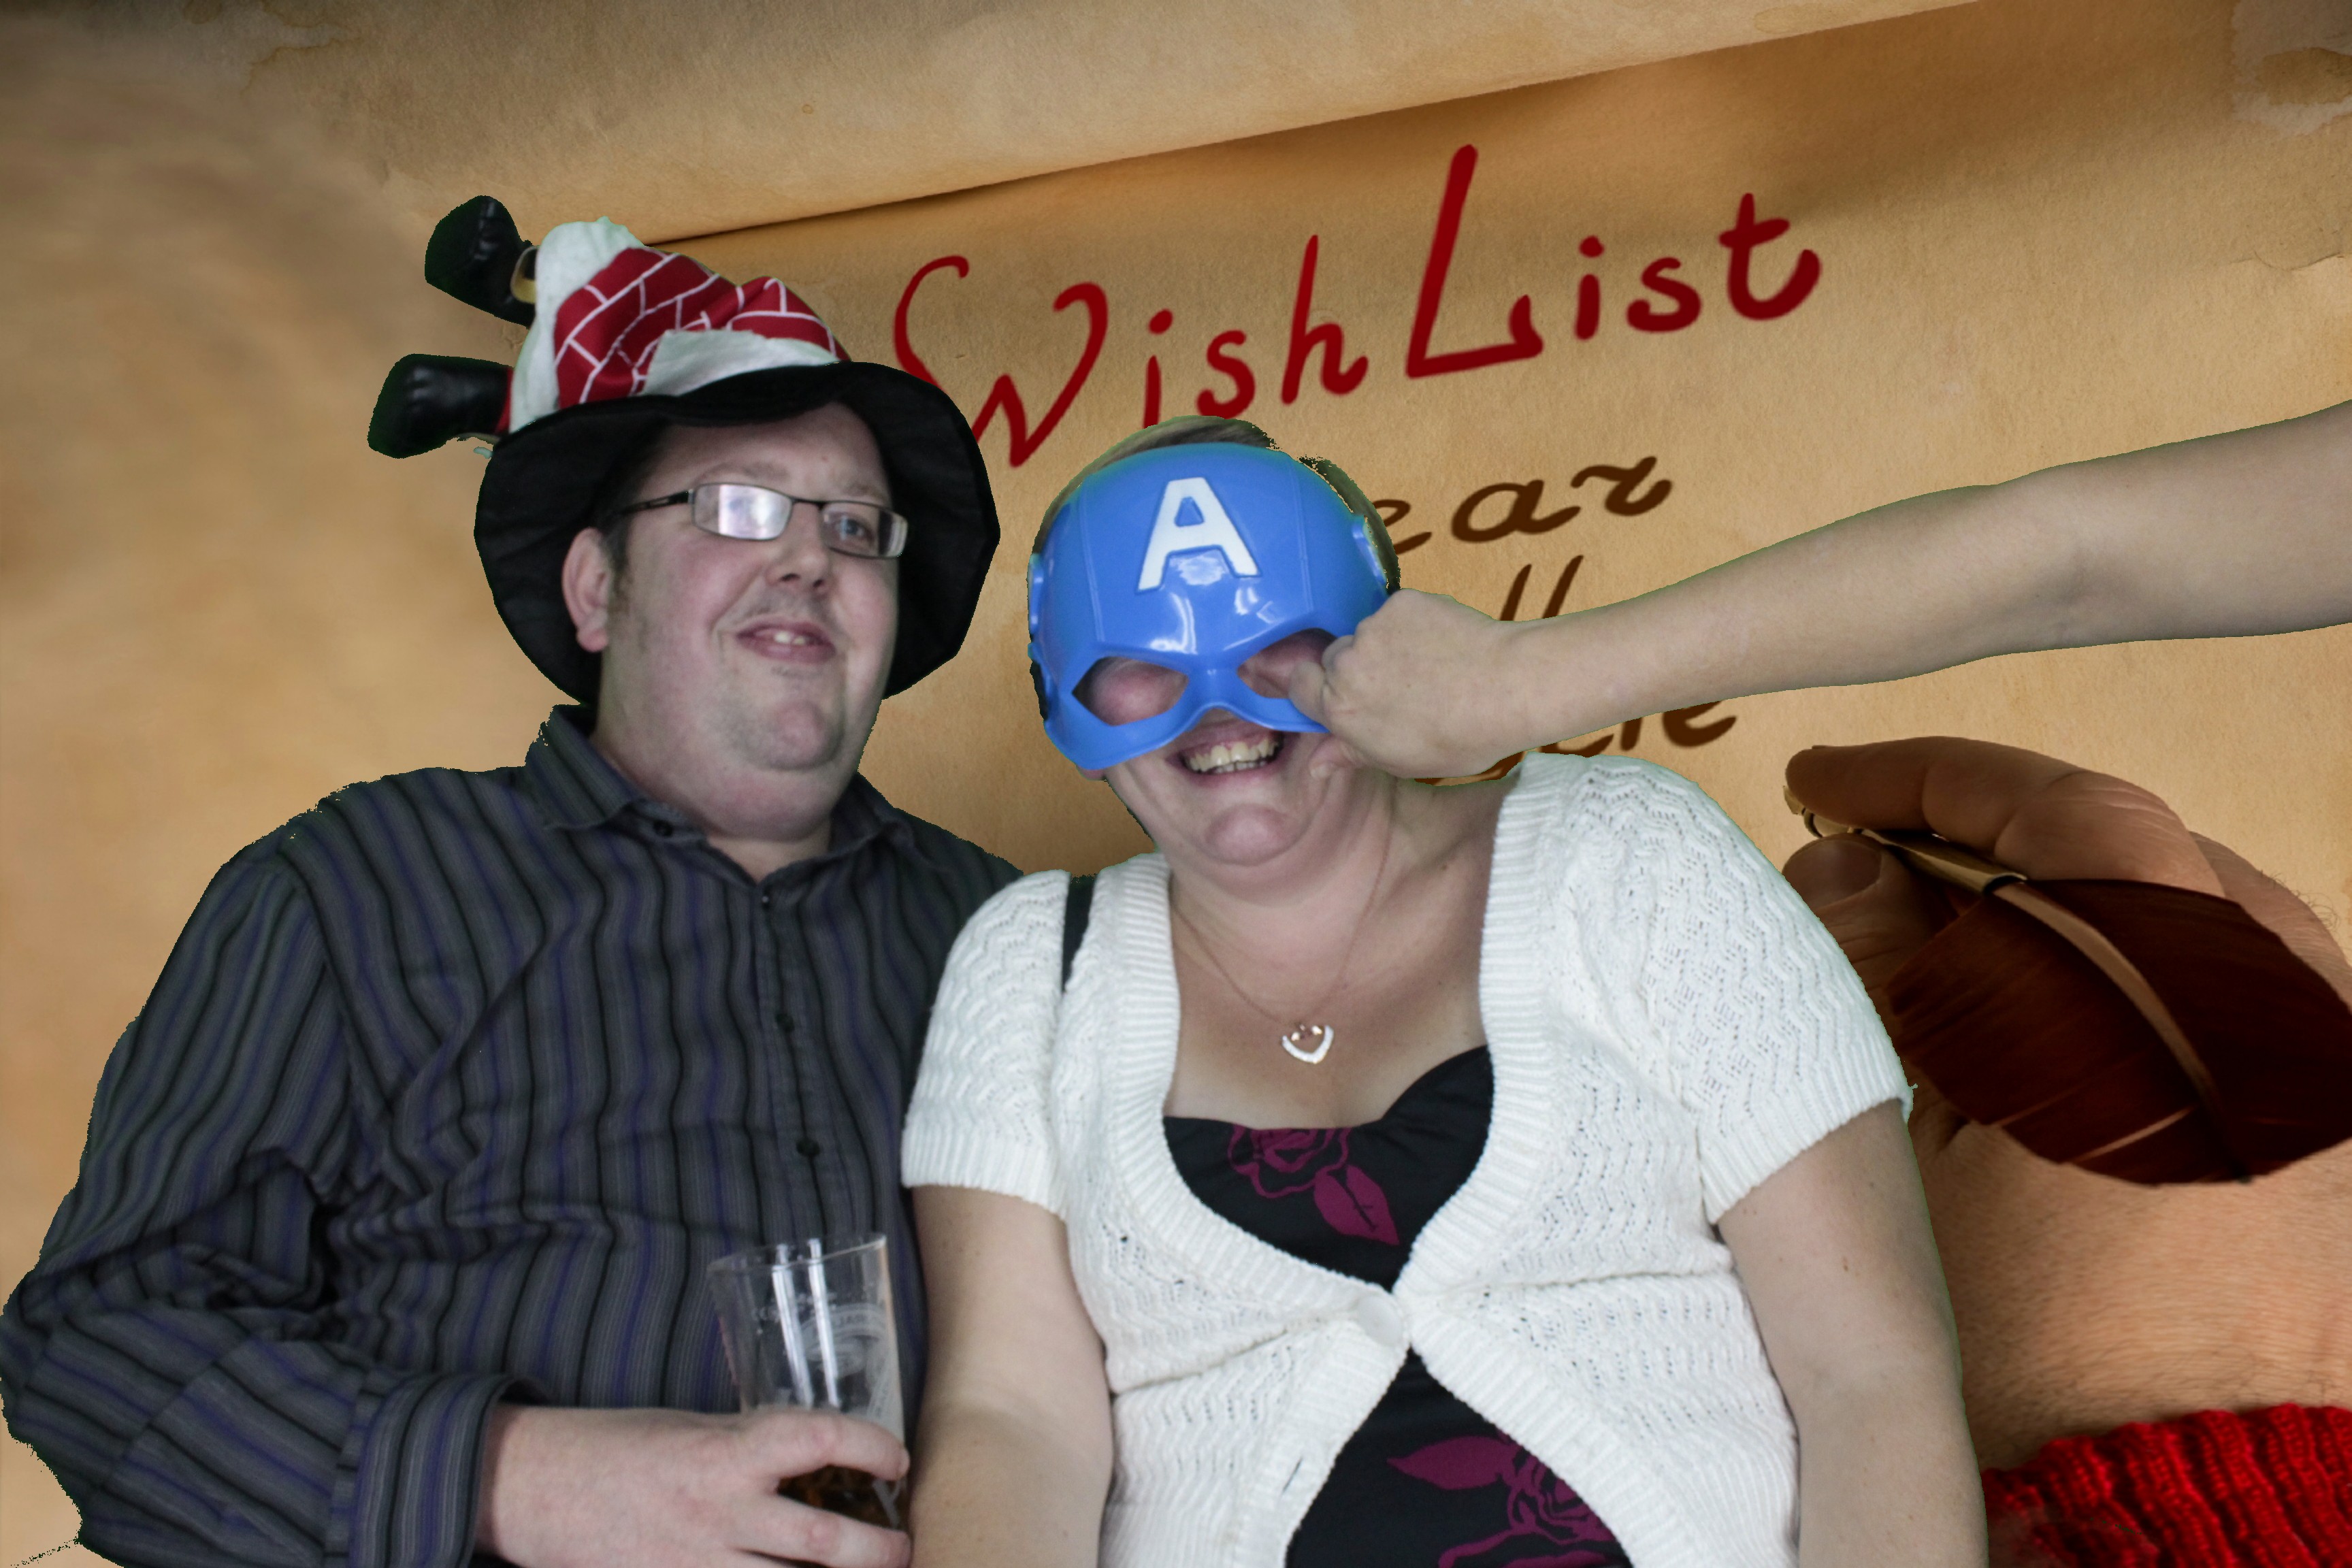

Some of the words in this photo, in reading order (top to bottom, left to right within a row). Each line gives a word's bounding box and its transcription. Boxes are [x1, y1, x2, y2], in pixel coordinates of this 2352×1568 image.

[892, 234, 1369, 469] Wish
[1405, 142, 1822, 379] List
[1136, 476, 1261, 593] A
[1371, 455, 1673, 557] ear
